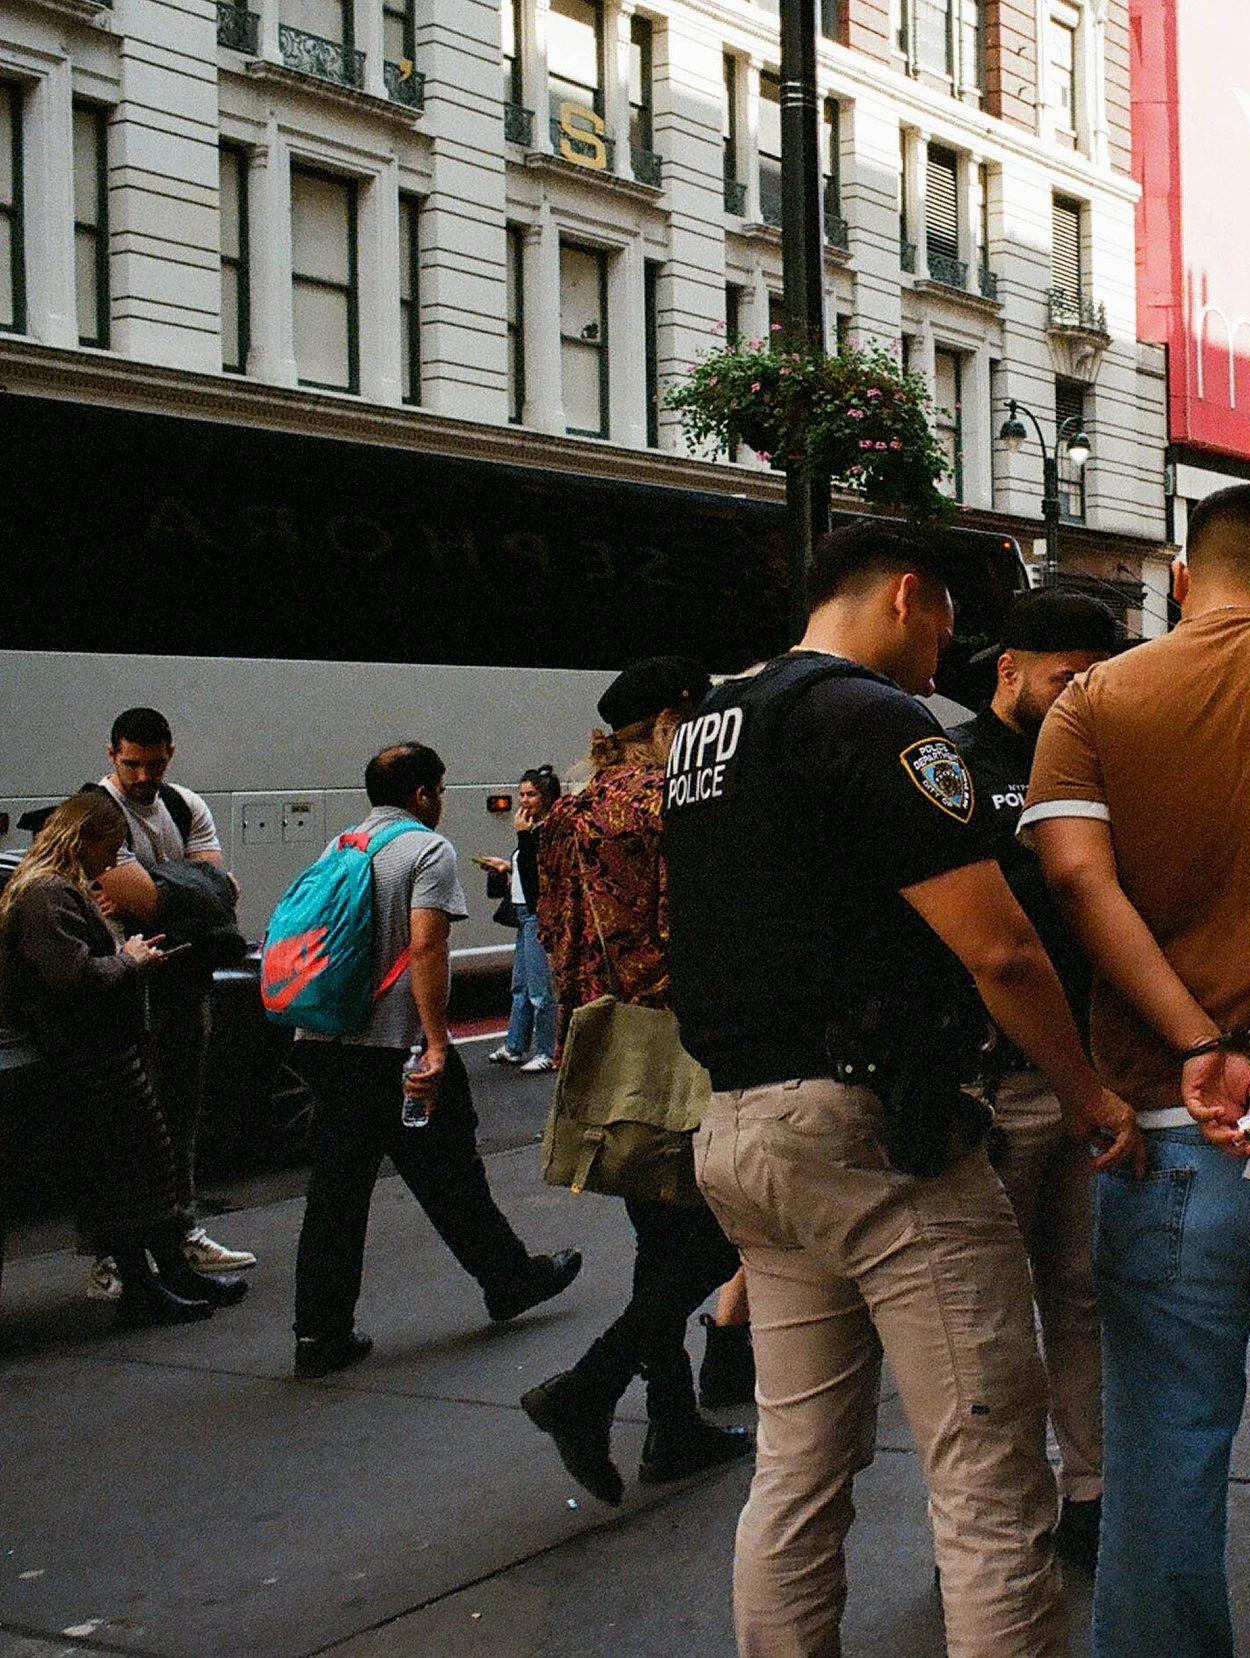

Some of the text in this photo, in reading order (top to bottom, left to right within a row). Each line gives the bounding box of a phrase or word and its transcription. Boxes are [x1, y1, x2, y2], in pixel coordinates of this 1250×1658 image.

[667, 707, 743, 778] NYPD
[913, 751, 958, 770] DEPART
[667, 765, 727, 809] POLICE
